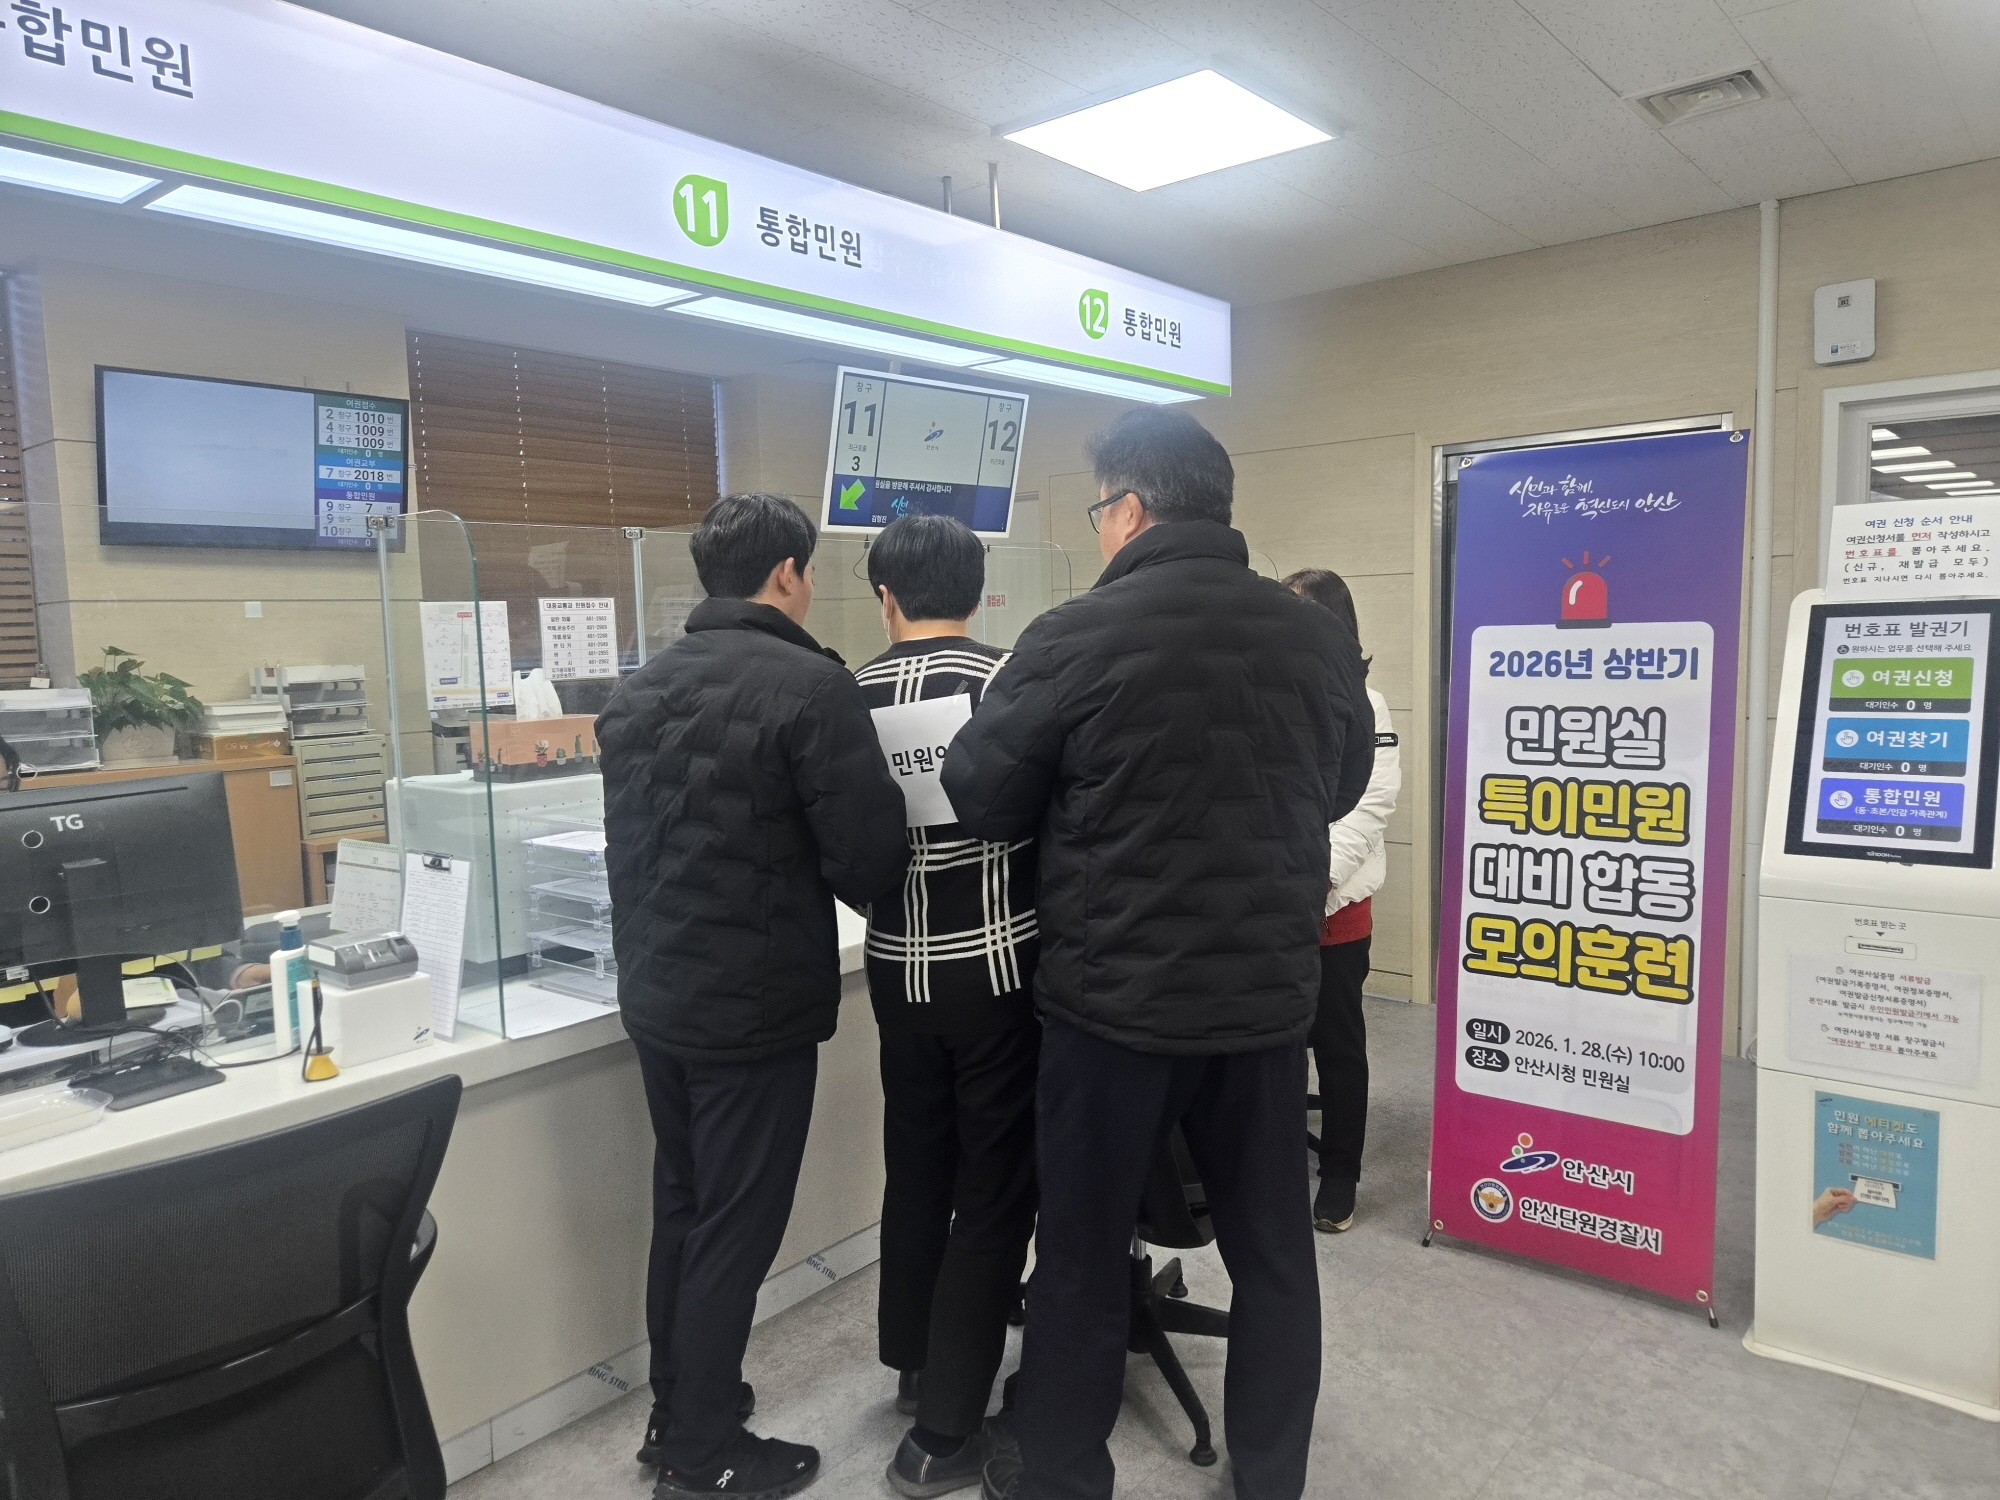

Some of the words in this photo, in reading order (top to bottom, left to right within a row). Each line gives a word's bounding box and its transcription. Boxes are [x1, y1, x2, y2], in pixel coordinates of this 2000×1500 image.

[0, 0, 194, 98] 합민원
[679, 183, 718, 239] 11
[756, 206, 862, 268] 통합민원
[1082, 294, 1107, 334] 12
[1123, 308, 1182, 349] 통합민원
[326, 409, 334, 419] 2
[354, 412, 385, 424] 1010
[844, 401, 877, 436] 11
[326, 422, 334, 432] 4
[354, 425, 385, 436] 1009
[988, 420, 1017, 452] 12
[326, 435, 334, 445] 4
[354, 437, 385, 449] 1009
[365, 449, 371, 457] 0
[851, 456, 861, 471] 3
[326, 468, 334, 478] 7
[354, 470, 384, 481] 2018
[926, 484, 952, 493] 감사합니다
[1509, 476, 1558, 504] 시민과
[326, 501, 333, 511] 9
[366, 503, 373, 513] 7
[1522, 502, 1571, 524] 자유로운
[1575, 498, 1630, 521] 혁신도시
[1635, 491, 1682, 513] 안산
[1865, 519, 1887, 528] 여권
[1893, 517, 1914, 527] 신청
[1921, 516, 1943, 526] 순서
[1949, 514, 1973, 524] 안내
[323, 526, 338, 536] 10
[1846, 533, 1905, 544] 여권신청서를
[1911, 532, 1932, 541] 먼저
[1937, 529, 1991, 540] 작성하시고
[1915, 573, 1932, 581] 다시
[1844, 622, 1902, 639] 번호표
[1909, 620, 1969, 637] 발권기
[1851, 645, 1885, 653] 원하시는
[1916, 644, 1942, 652] 선택해
[1944, 643, 1971, 652] 주세요
[1489, 648, 1593, 680] 2026년
[1603, 647, 1699, 680] 상반기
[1872, 669, 1953, 687] 여권신청
[1865, 700, 1899, 709] 대기인수
[1906, 700, 1916, 711] 0
[1923, 701, 1932, 710] 명
[1506, 705, 1666, 770] 민원실
[1866, 730, 1948, 748] 여권찾기
[1859, 762, 1893, 771] 대기인수
[1901, 762, 1910, 773] 0
[1918, 764, 1927, 772] 명
[1863, 788, 1941, 807] 통합민원
[1478, 774, 1690, 847] 특이민원
[50, 814, 84, 832] TG
[1853, 824, 1887, 834] 대기인수
[1895, 825, 1905, 836] 0
[1913, 827, 1922, 836] 명
[1469, 843, 1573, 910] 대비
[1581, 850, 1696, 922] 합동
[1854, 917, 1878, 927] 번호표
[1880, 920, 1896, 929] 받는
[1898, 922, 1907, 931] 곳
[1463, 912, 1694, 1005] 모의훈련
[1472, 1021, 1502, 1043] 일시
[1515, 1029, 1558, 1052] 2026.
[1563, 1038, 1576, 1055] 1.
[1639, 1051, 1685, 1073] 10:00
[1472, 1049, 1502, 1068] 장소
[1514, 1056, 1577, 1084] 안산시청
[1583, 1069, 1630, 1093] 민원실
[1834, 1110, 1860, 1125] 민원
[1827, 1122, 1853, 1136] 함께
[1858, 1128, 1925, 1149] 뽑아주세요
[1562, 1158, 1634, 1194] 안산시
[1519, 1197, 1662, 1255] 안산단원경찰서
